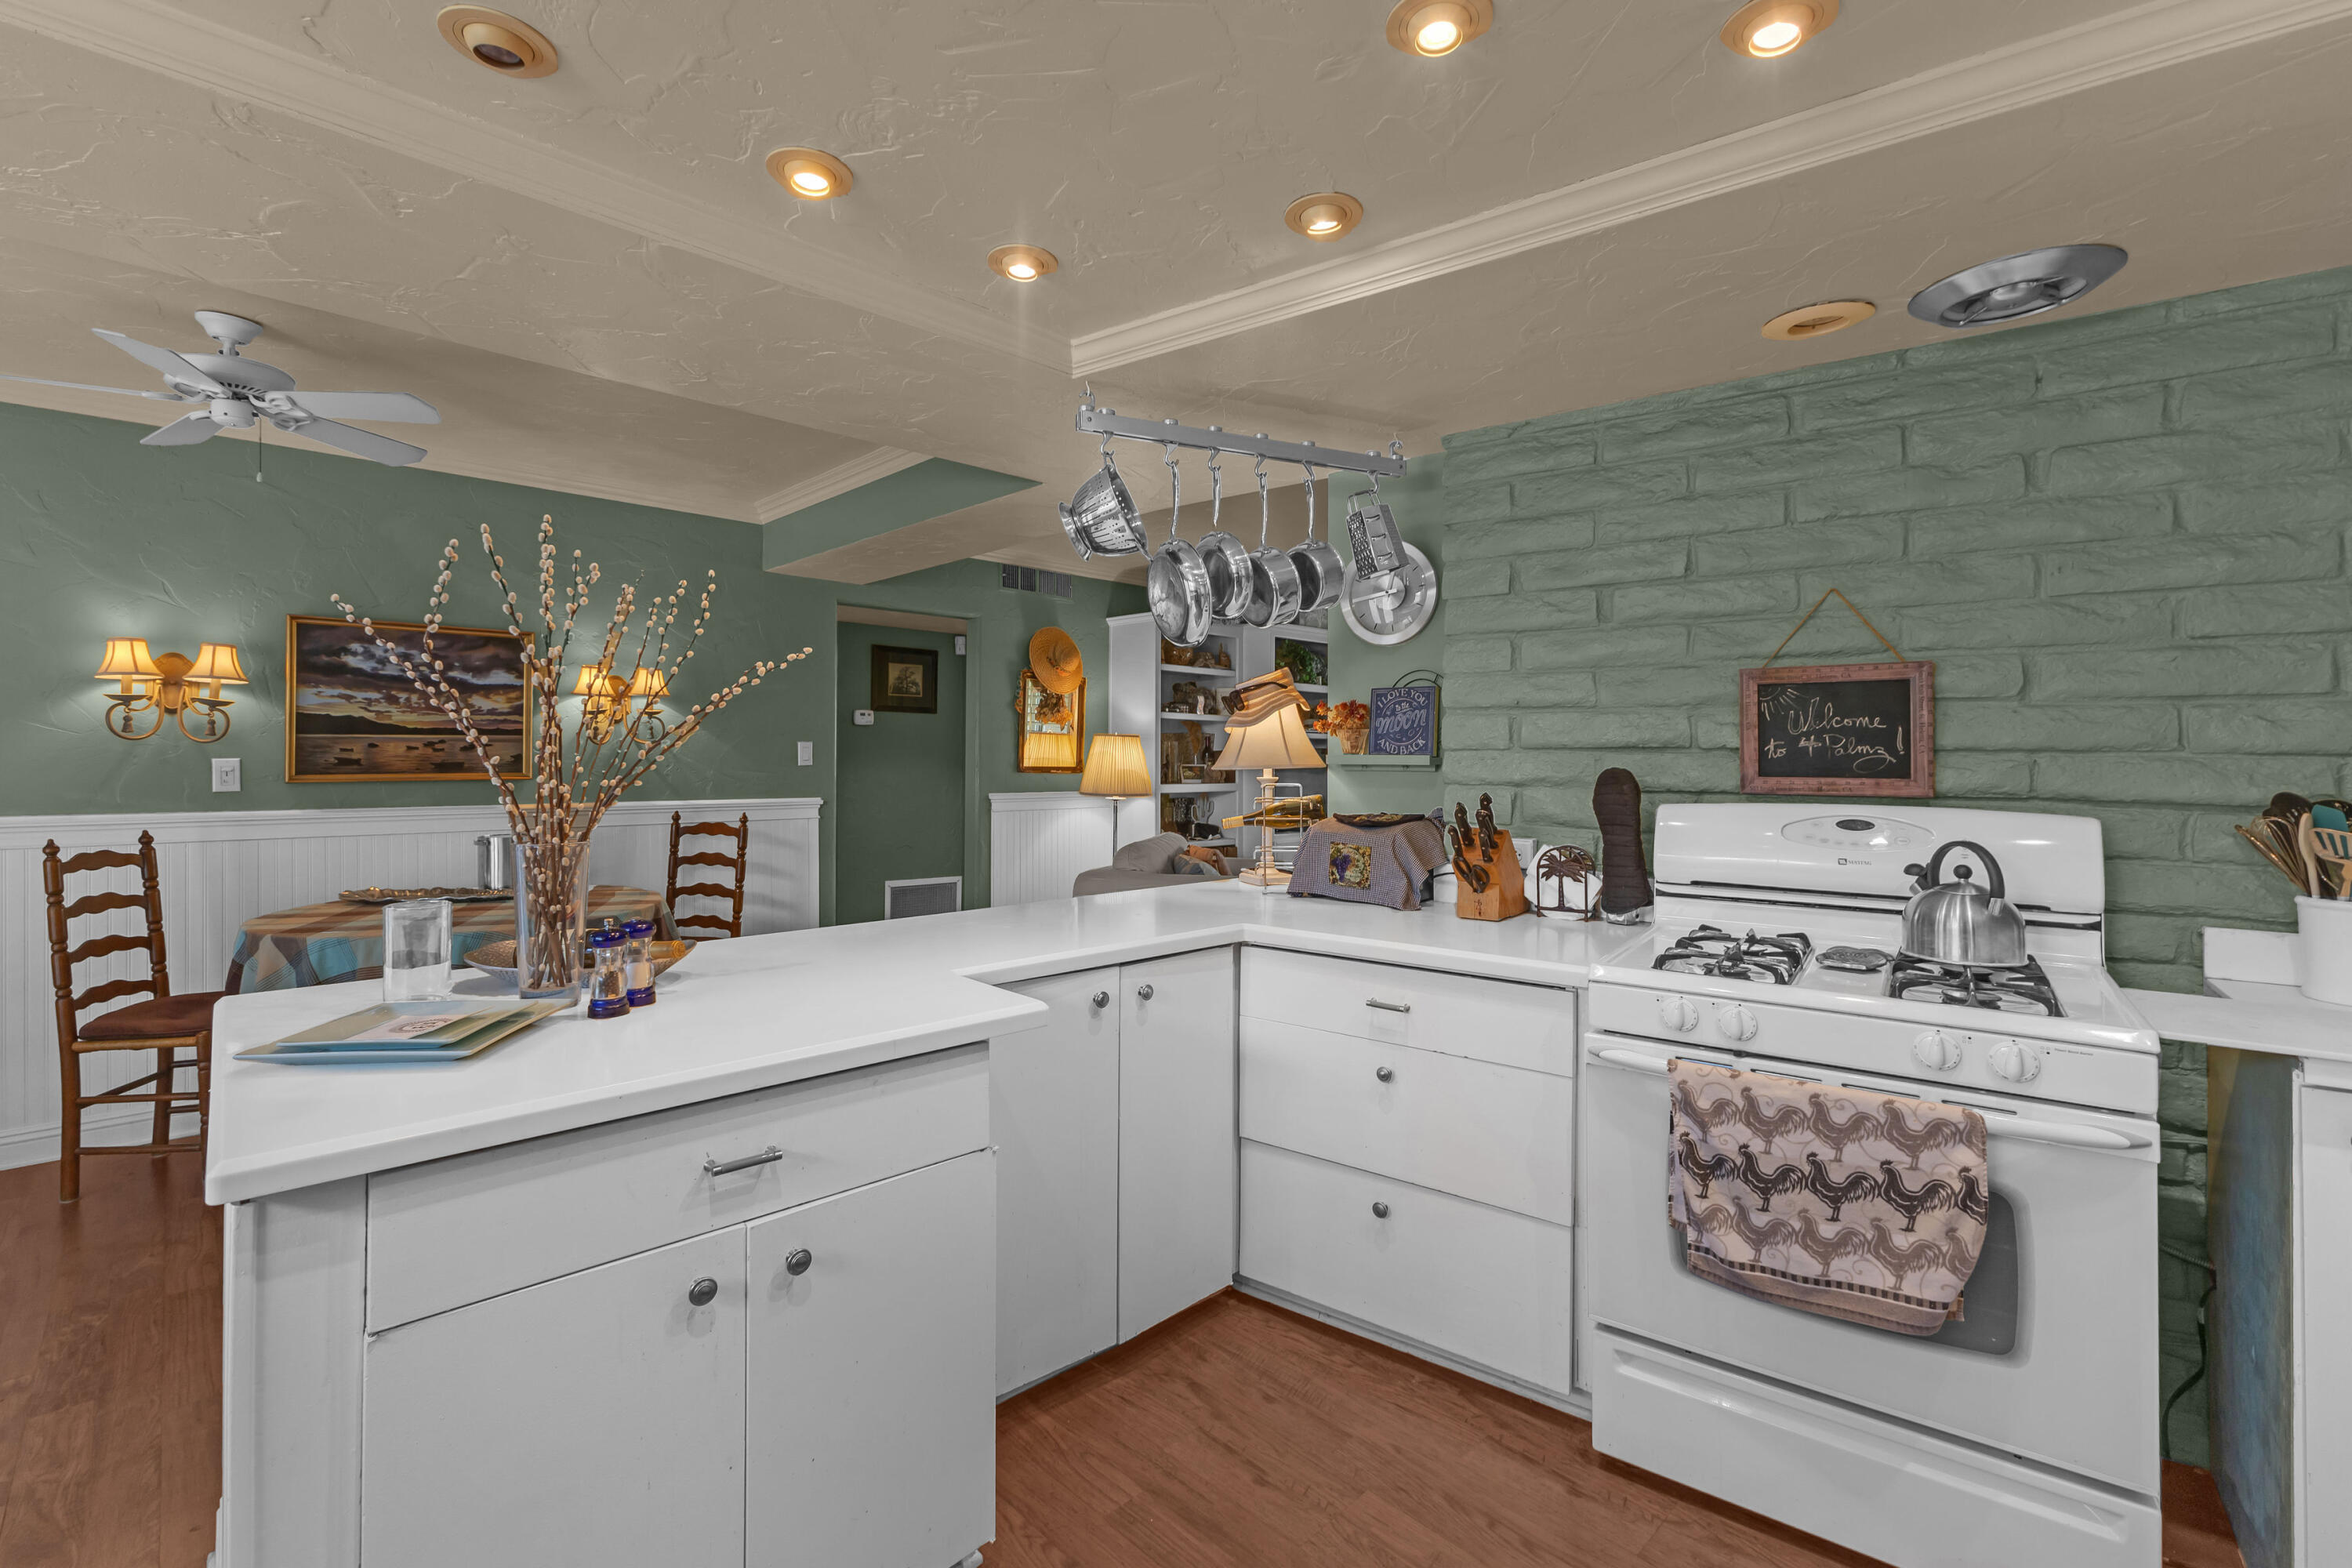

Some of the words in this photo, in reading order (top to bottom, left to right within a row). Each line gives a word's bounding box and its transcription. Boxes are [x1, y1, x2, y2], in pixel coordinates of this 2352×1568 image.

[1381, 688, 1408, 703] LOVE
[1411, 690, 1428, 706] YOU
[1788, 696, 1887, 735] Welcome
[1377, 739, 1398, 754] AND
[1399, 737, 1426, 755] BACK
[1765, 738, 1787, 759] to
